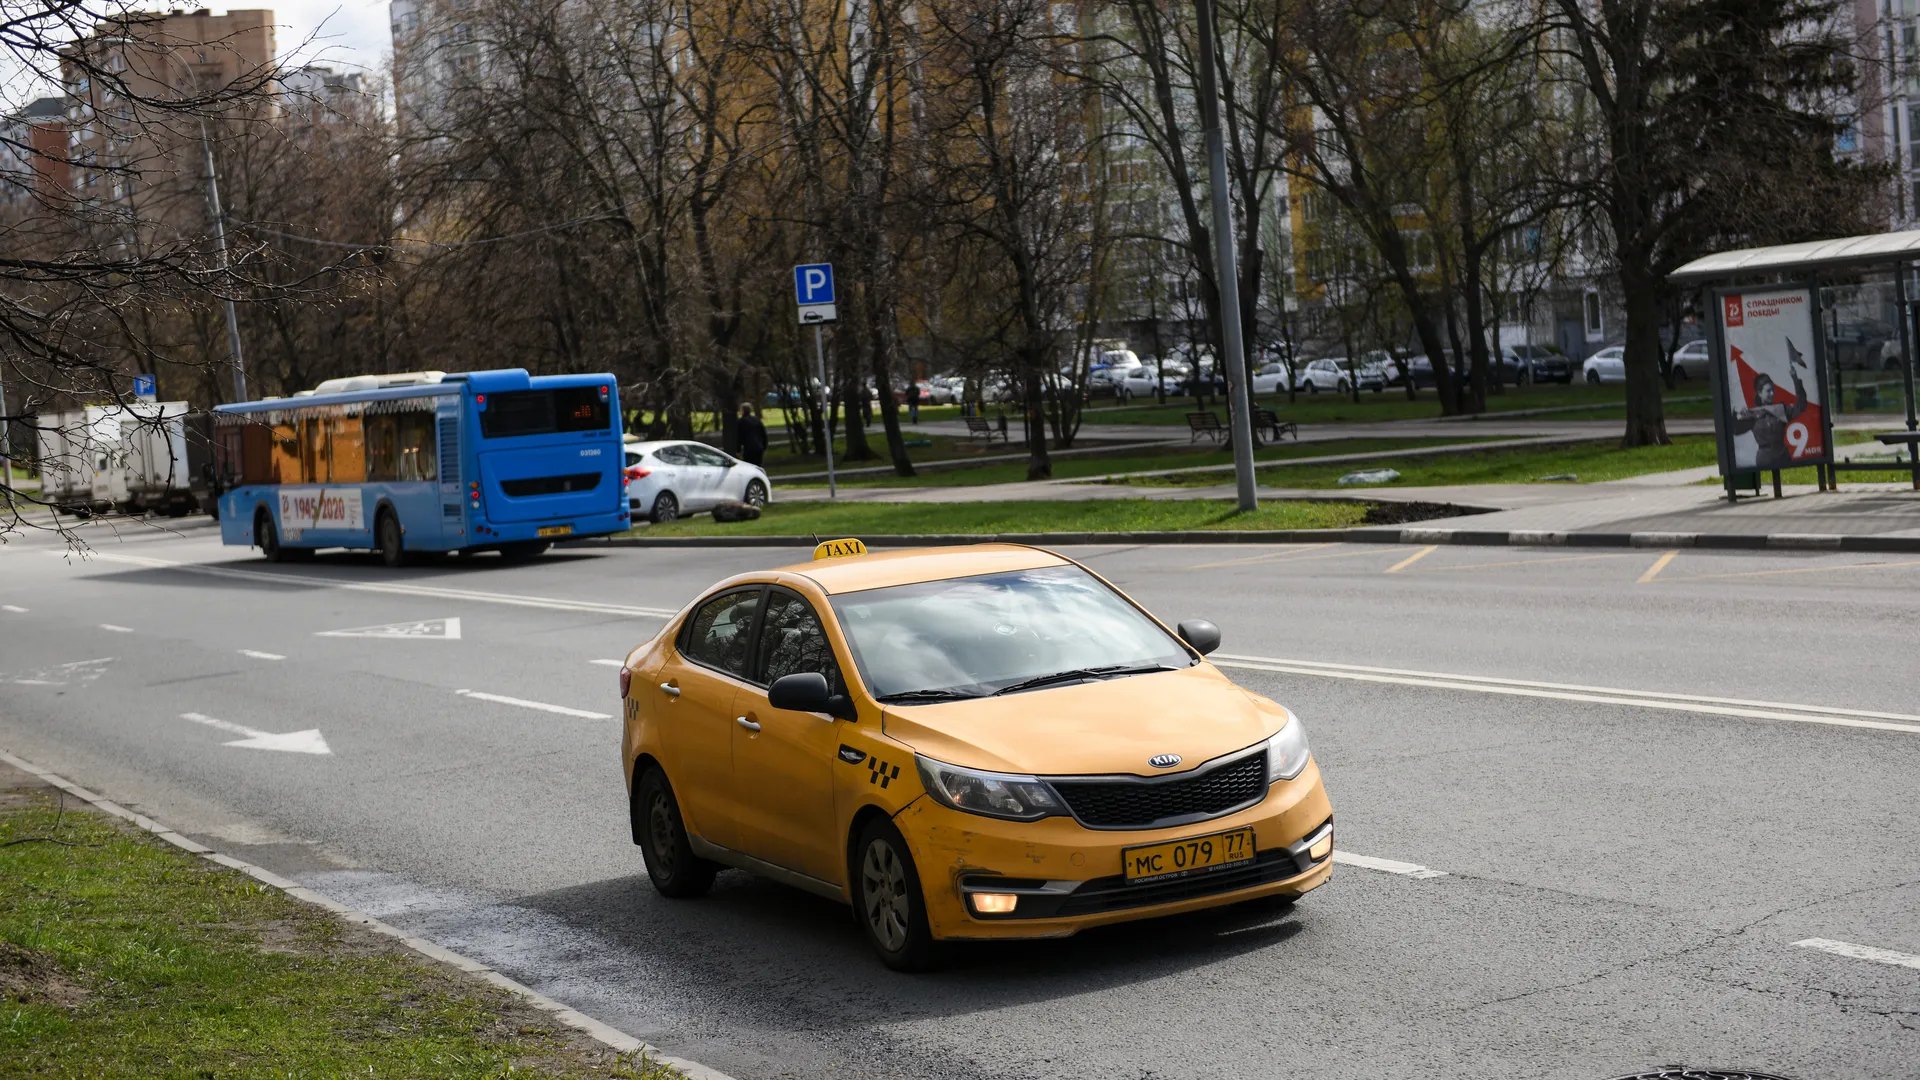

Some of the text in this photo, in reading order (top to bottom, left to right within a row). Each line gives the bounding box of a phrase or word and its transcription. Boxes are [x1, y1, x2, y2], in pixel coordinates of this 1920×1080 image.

[805, 269, 826, 300] P
[1752, 296, 1803, 307] ПРАЗДНИКОМ
[1747, 308, 1780, 318] ПОБЕДЫ!
[1786, 422, 1808, 458] 9
[294, 496, 317, 521] 1945
[322, 496, 345, 520] 2020
[822, 541, 861, 557] TAXI
[1153, 755, 1178, 766] KIA
[1136, 833, 1245, 874] MC 079 77
